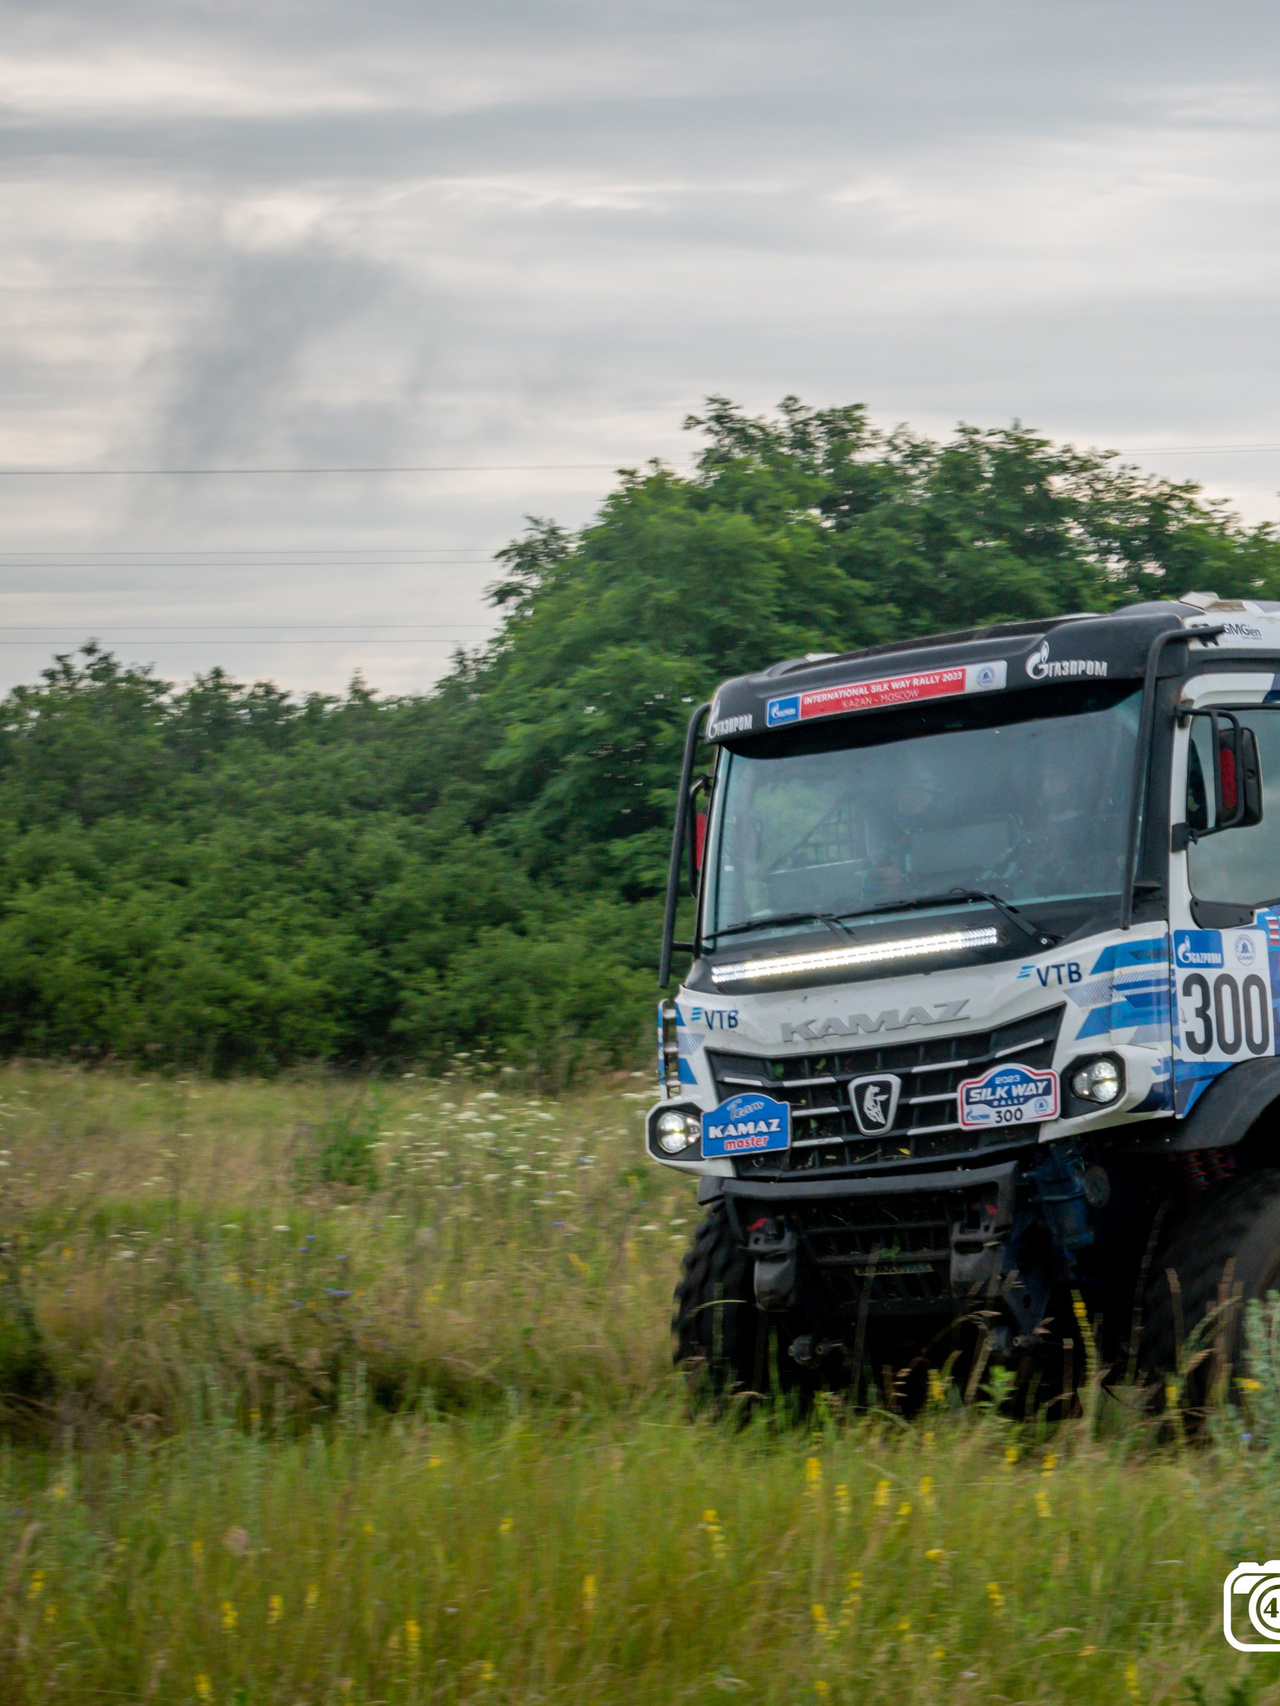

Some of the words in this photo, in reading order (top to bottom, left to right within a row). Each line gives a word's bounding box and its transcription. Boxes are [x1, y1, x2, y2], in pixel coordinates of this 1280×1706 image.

[1049, 660, 1108, 677] ГАЗПРОМ
[804, 687, 869, 705] INTERNATIONAL
[870, 682, 890, 695] SILK
[891, 679, 911, 691] WAY
[912, 674, 941, 686] RALLY
[942, 671, 963, 682] 2023
[842, 697, 873, 709] KAZAN
[880, 690, 919, 703] MOSCOW
[717, 714, 753, 737] ГАЗПРОМ
[1190, 952, 1222, 964] GAZPROM
[1036, 961, 1083, 987] VTB
[704, 1009, 739, 1031] VTB
[780, 999, 971, 1042] KAMAZ
[1182, 972, 1270, 1055] 300
[995, 1074, 1021, 1084] 2023
[969, 1085, 1010, 1102] SILK
[1011, 1081, 1049, 1098] WAY
[992, 1097, 1025, 1107] RALLY
[726, 1098, 765, 1121] Team
[995, 1107, 1024, 1124] 300
[708, 1118, 781, 1139] KAMAZ
[724, 1135, 770, 1151] master
